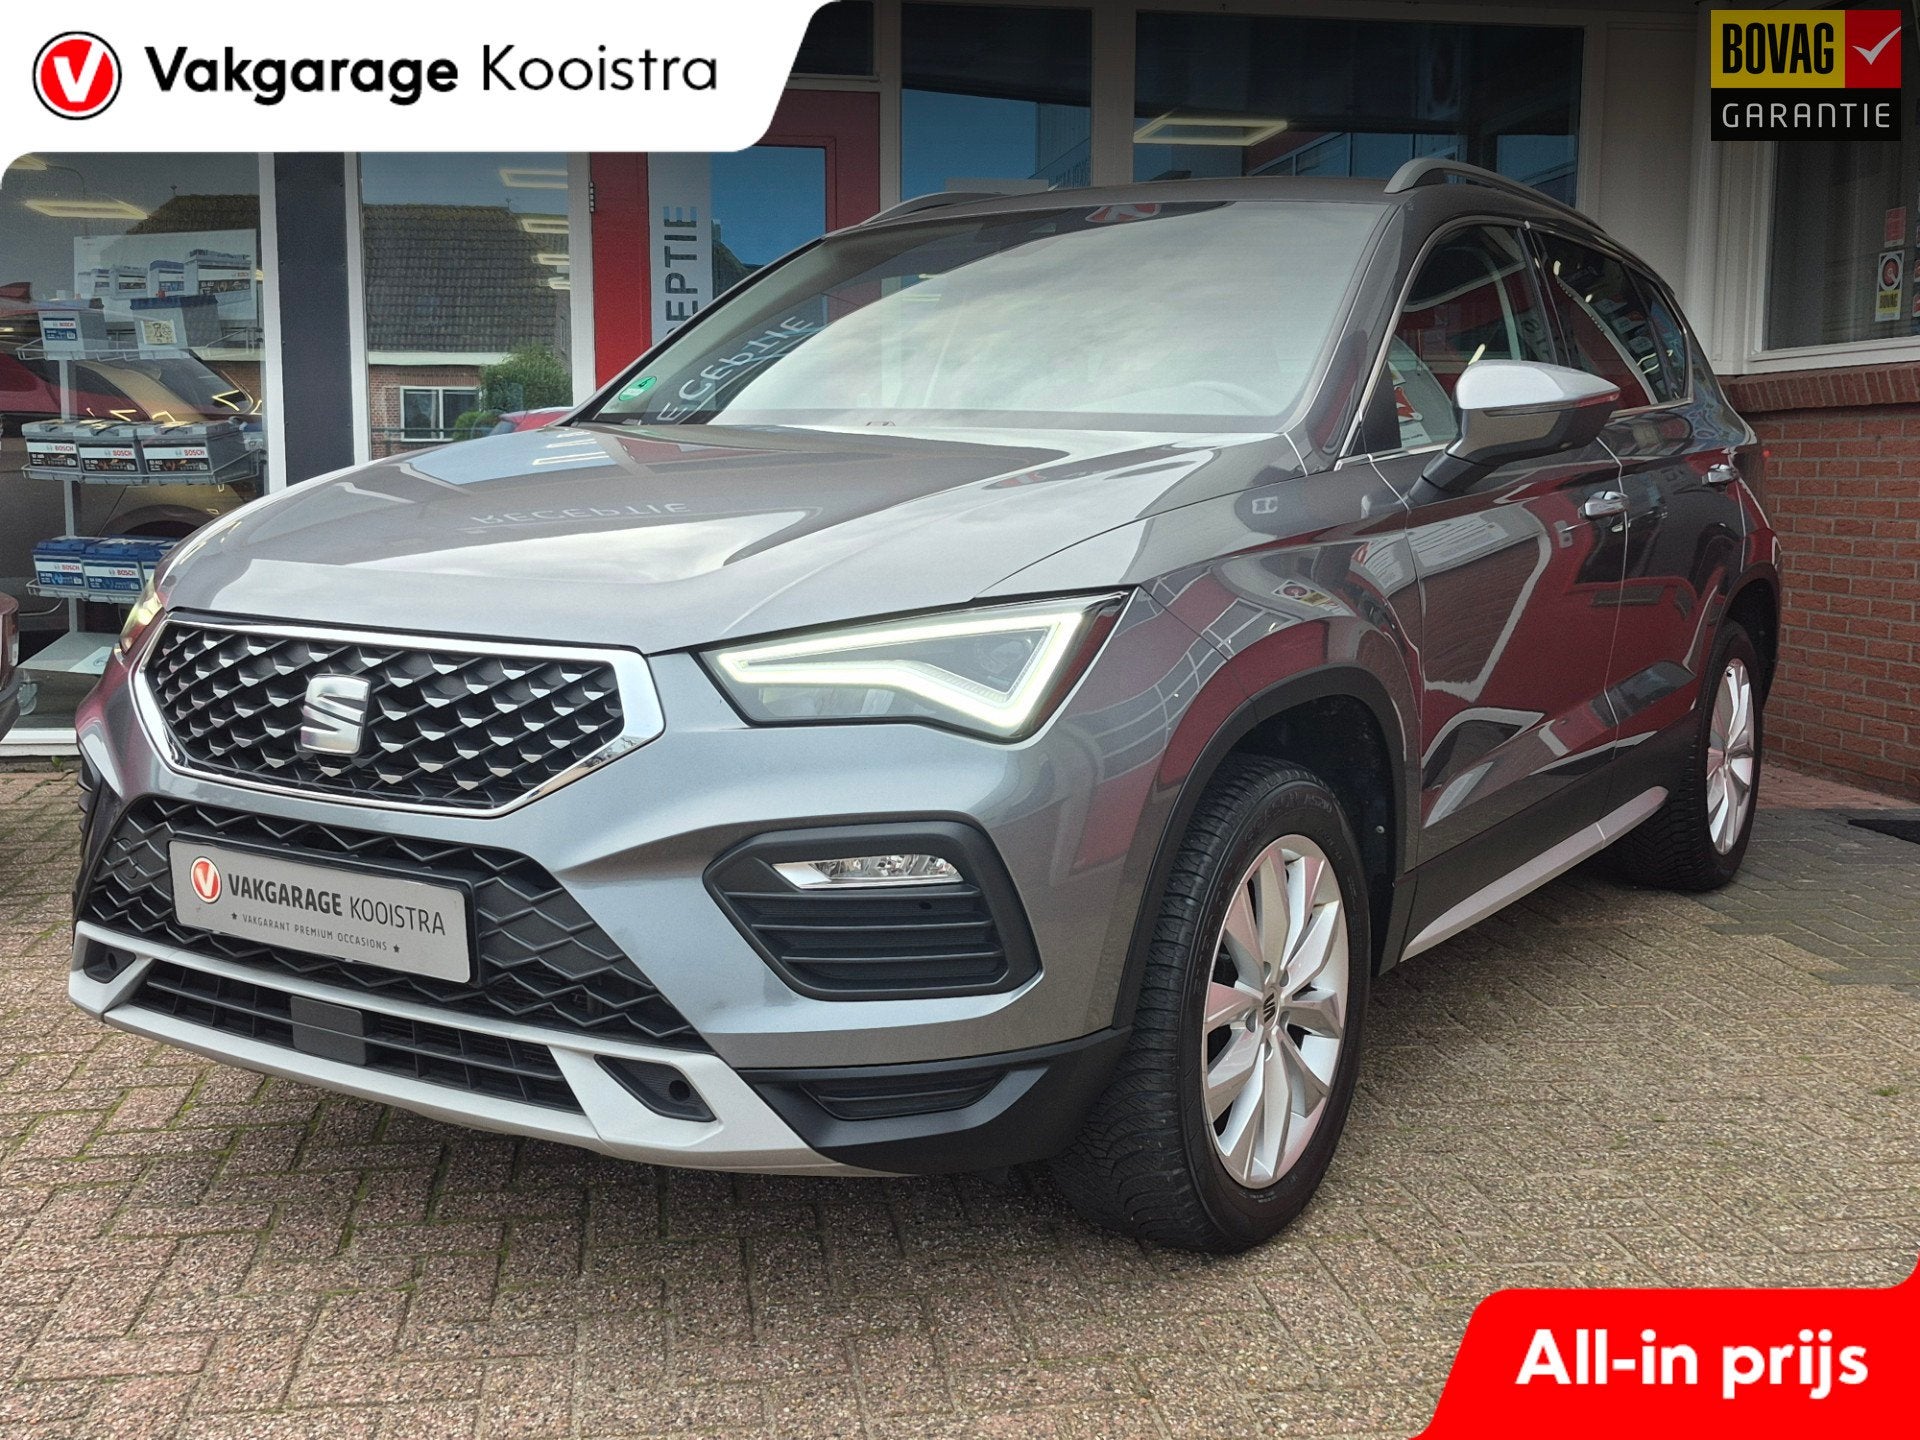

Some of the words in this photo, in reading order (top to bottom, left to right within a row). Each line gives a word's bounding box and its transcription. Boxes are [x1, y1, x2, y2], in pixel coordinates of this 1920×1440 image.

[663, 206, 698, 336] EPTIE
[54, 444, 75, 453] BOSCH
[184, 448, 206, 457] BOSCH
[112, 449, 133, 458] BOSCH
[61, 563, 81, 572] BOSCH
[116, 568, 137, 577] BOSCH
[228, 873, 343, 916] VAKGARAGE
[350, 896, 446, 936] KOOISTRA
[242, 913, 291, 931] VAKGARANT
[294, 925, 333, 940] PREMIUM
[337, 932, 388, 951] OCCASIONS
